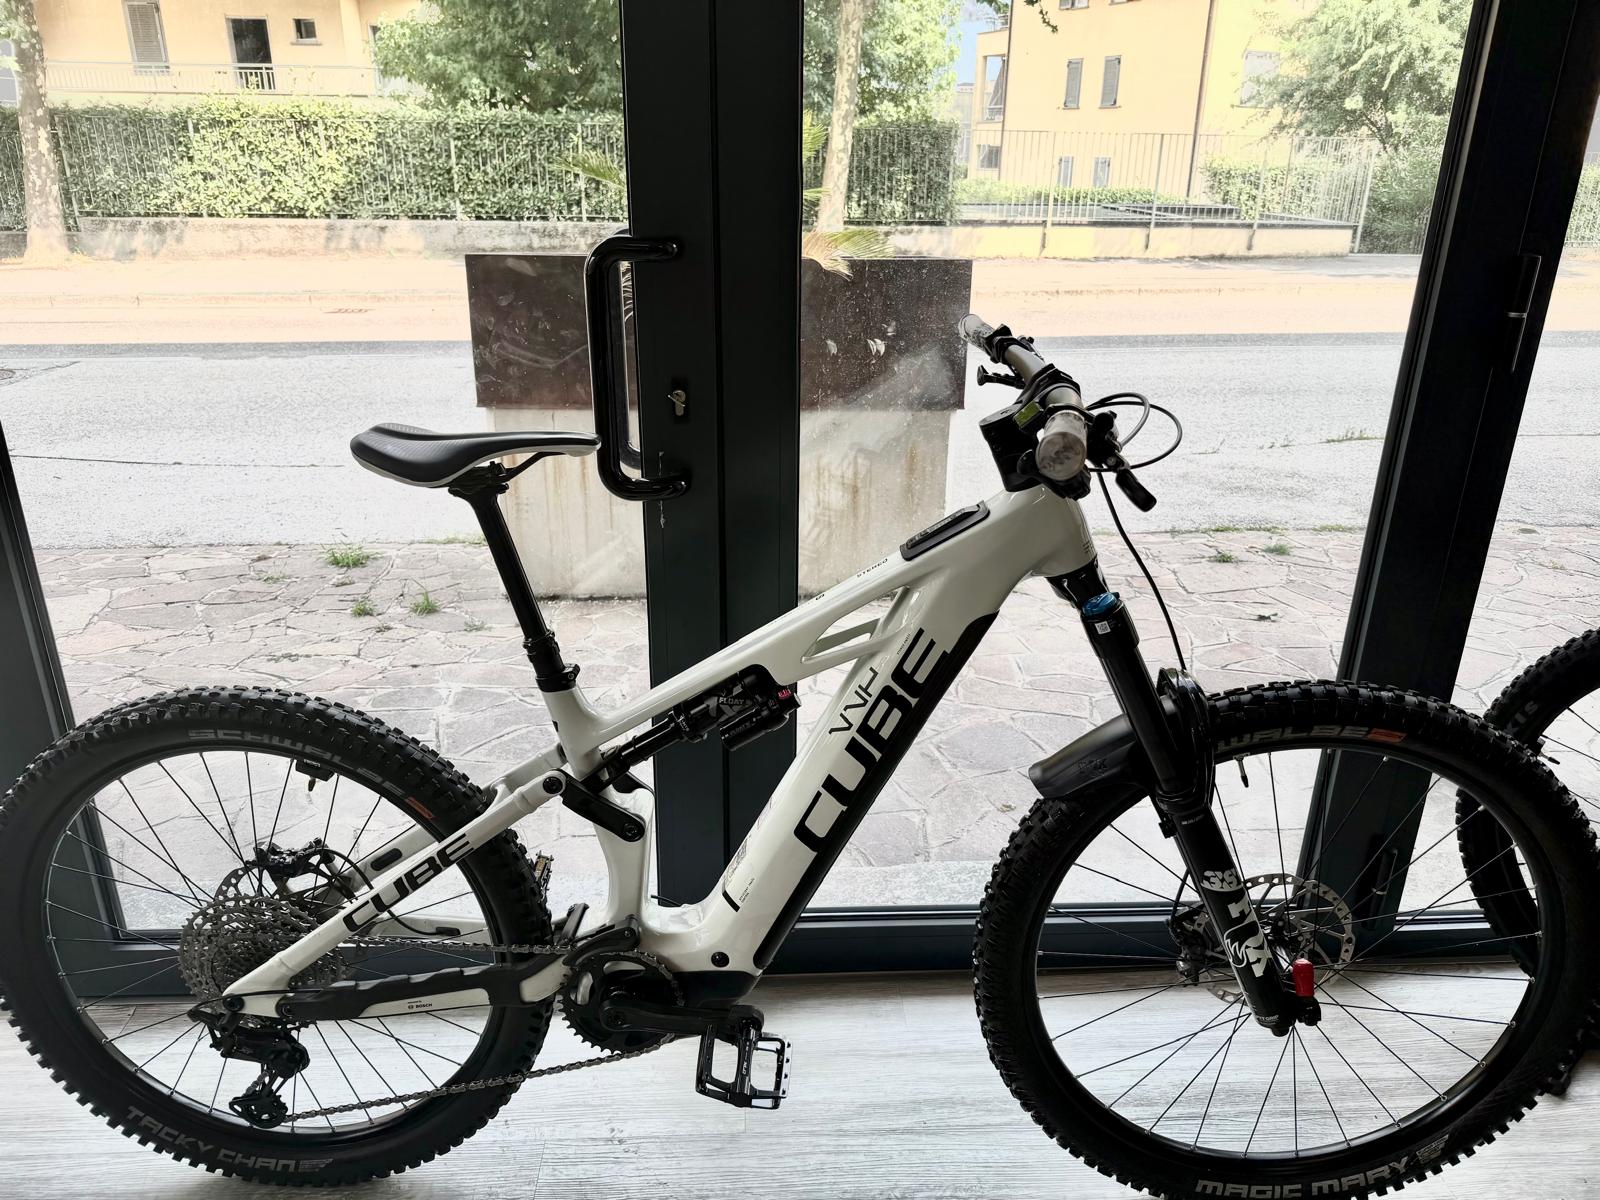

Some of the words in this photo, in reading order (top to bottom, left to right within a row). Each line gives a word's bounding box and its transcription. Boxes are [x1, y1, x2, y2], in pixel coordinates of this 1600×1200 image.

[793, 627, 951, 853] CUBE
[342, 833, 474, 932] CUBE
[127, 1106, 214, 1153] TACKY
[217, 1148, 296, 1173] CHAN
[1195, 1179, 1302, 1200] MAGIC
[1311, 1156, 1409, 1196] MARY
